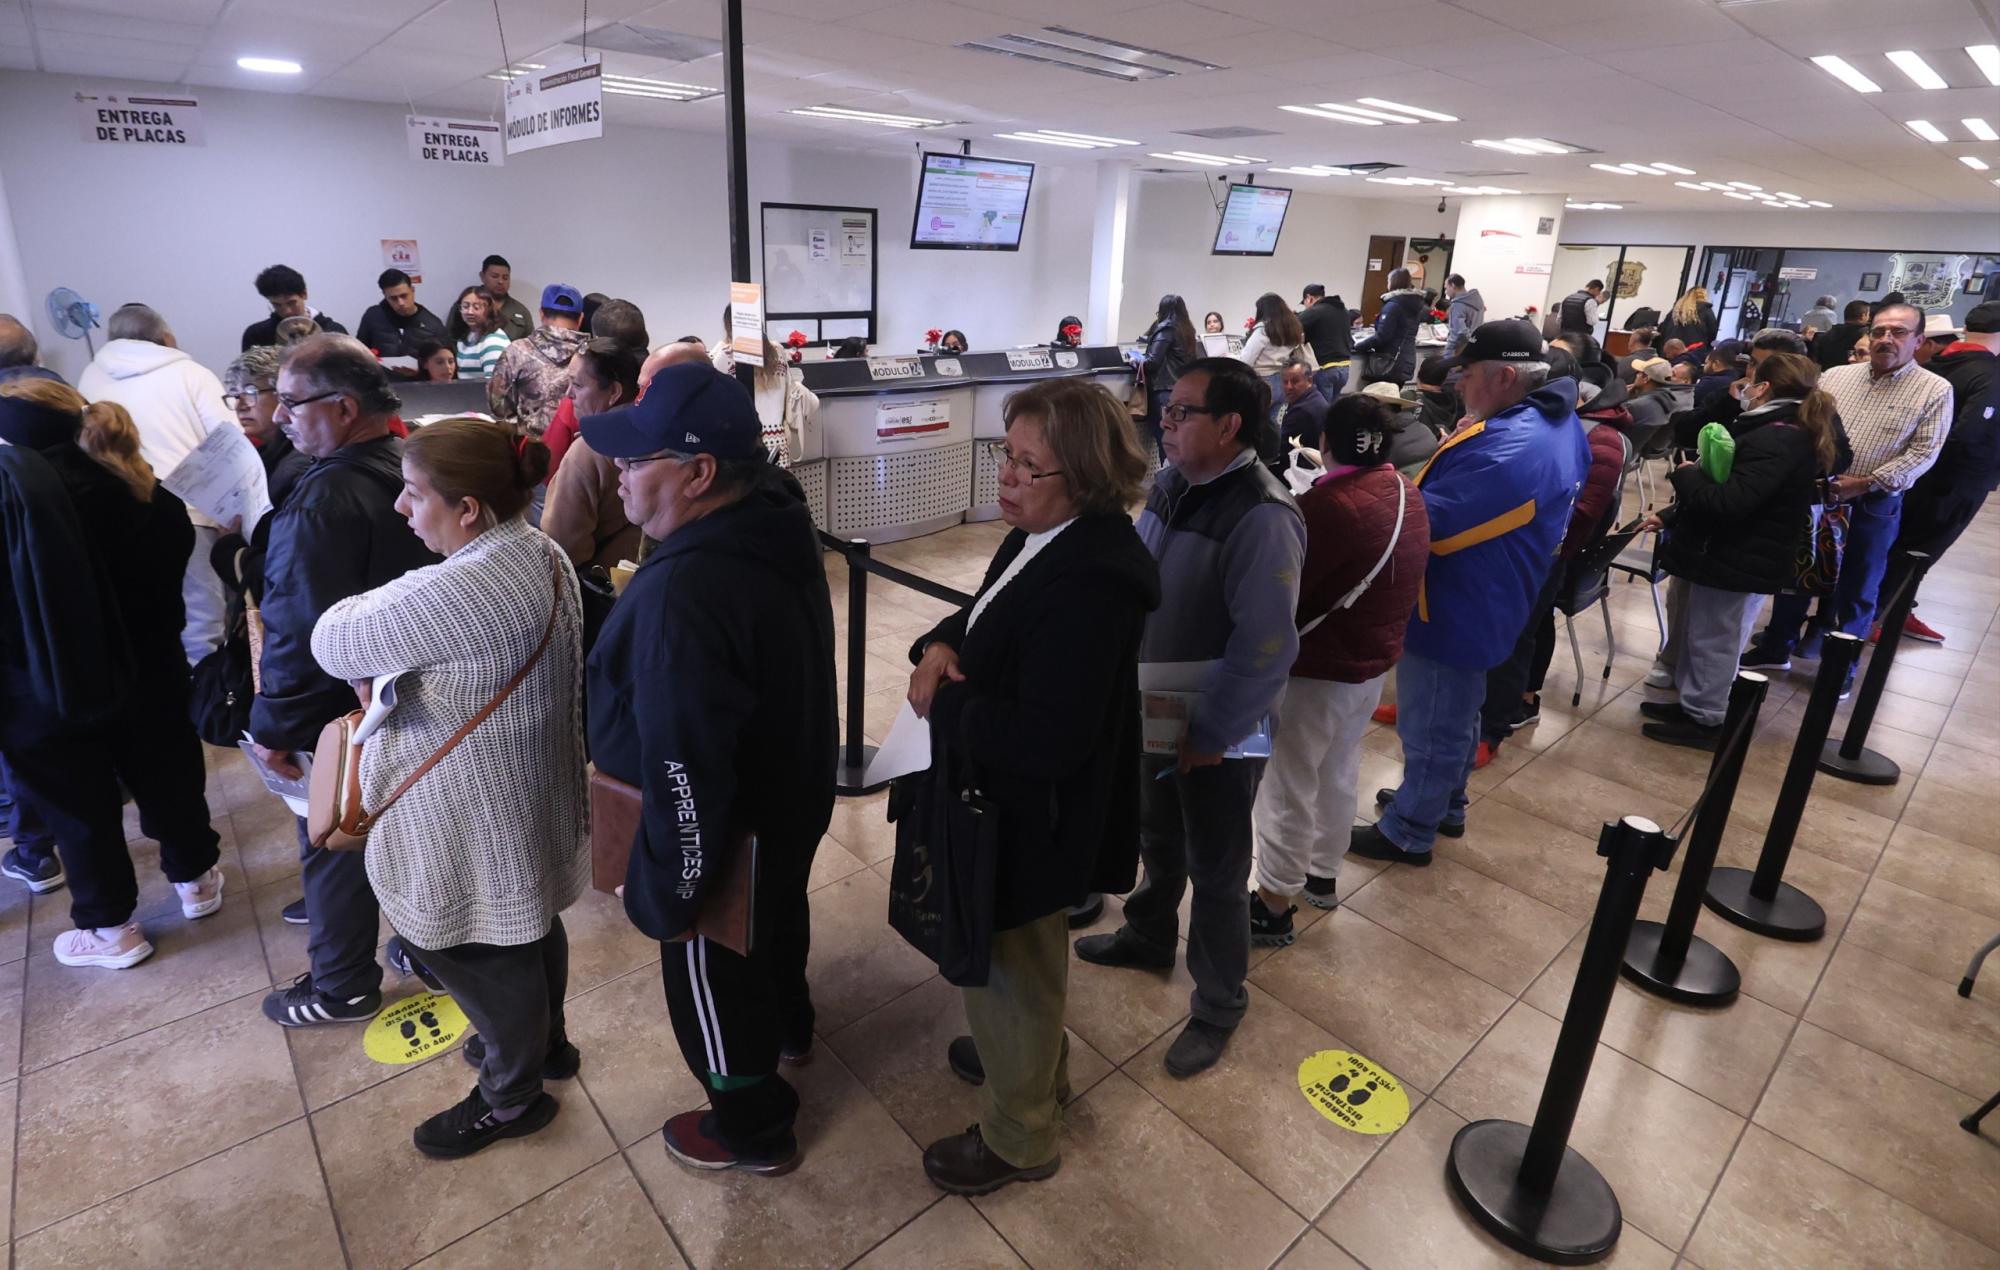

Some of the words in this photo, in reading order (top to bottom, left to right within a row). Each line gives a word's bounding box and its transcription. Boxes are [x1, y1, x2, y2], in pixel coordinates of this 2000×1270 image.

[97, 109, 173, 126] ENTREGA
[507, 115, 535, 140] MÓDULO
[537, 112, 548, 132] DE
[550, 101, 599, 130] INFORMES
[96, 126, 119, 141] DE
[123, 128, 186, 143] PLACAS
[424, 132, 480, 148] ENTREGA
[423, 147, 439, 160] DE
[442, 149, 489, 163] PLACAS
[872, 366, 910, 377] MODULO
[664, 760, 701, 900] APPRENTICESHIP
[385, 1001, 438, 1027] DISTANCIA
[1306, 1087, 1319, 1098] TU
[1314, 1082, 1364, 1121] DISTANCIA
[1319, 1097, 1357, 1128] GUARDA
